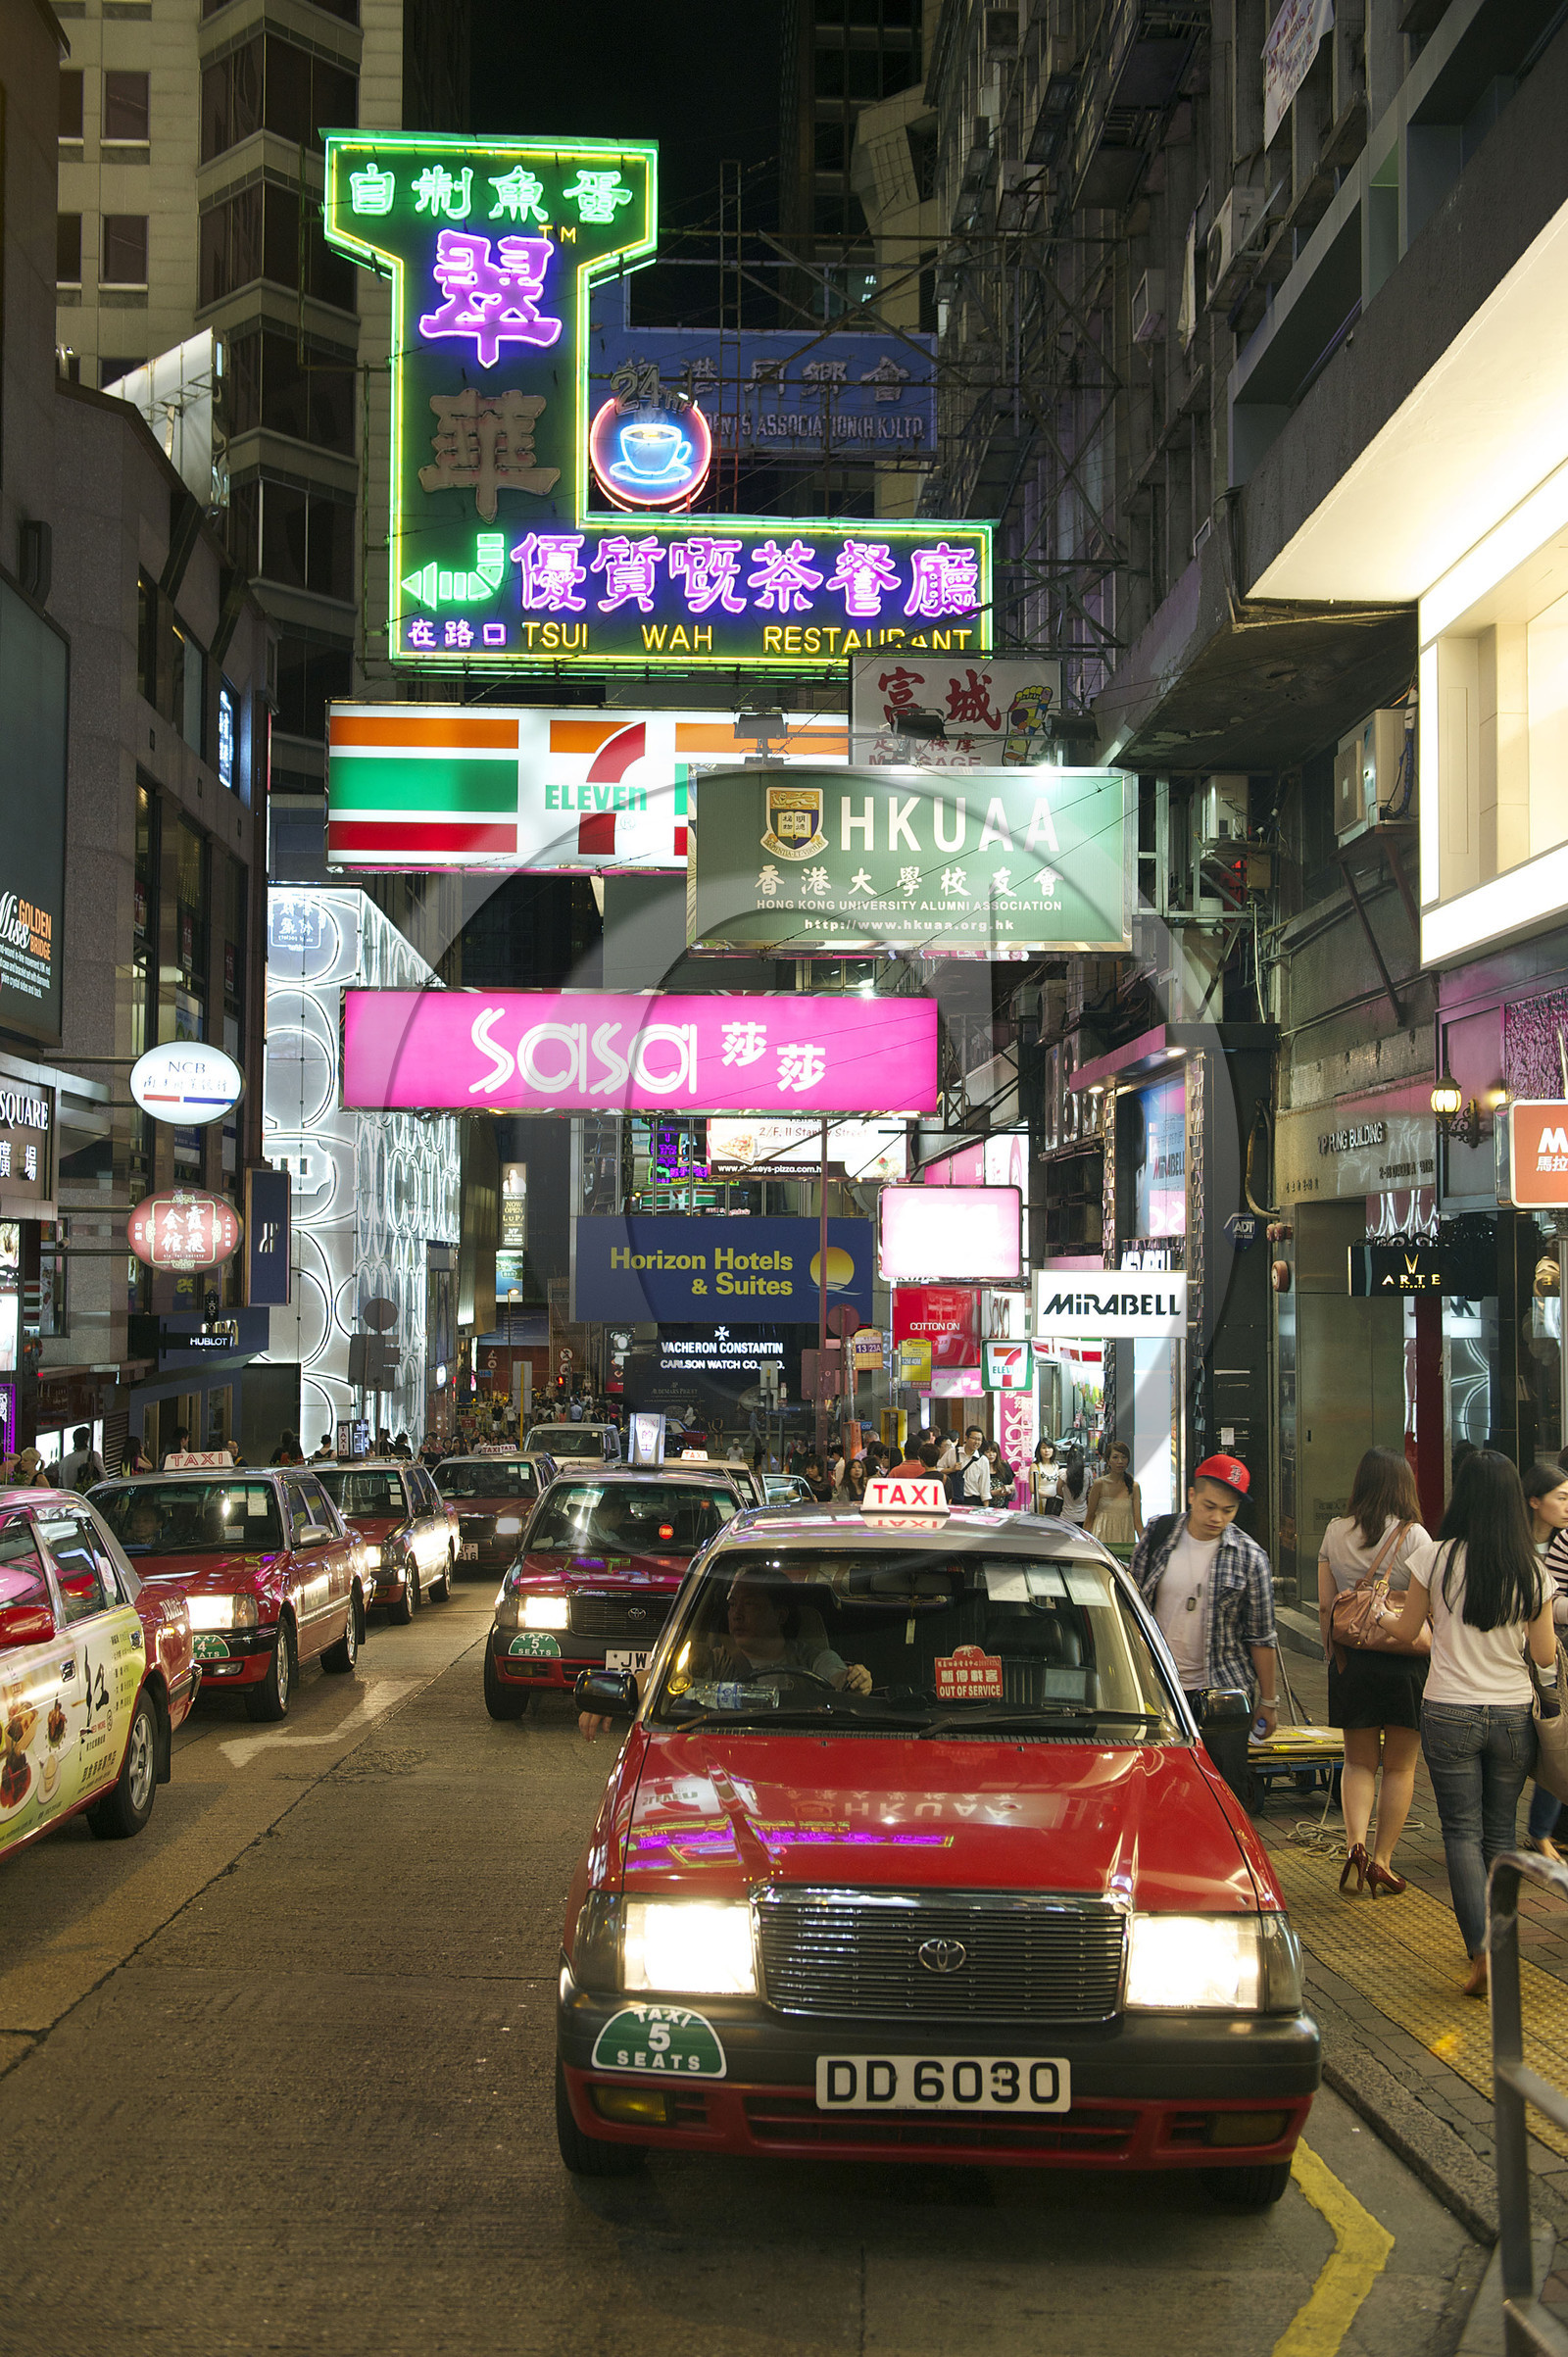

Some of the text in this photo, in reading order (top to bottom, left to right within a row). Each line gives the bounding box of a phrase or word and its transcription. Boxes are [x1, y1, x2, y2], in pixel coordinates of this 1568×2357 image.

[350, 163, 633, 224] 自制魚蛋
[538, 224, 576, 245] TM
[510, 532, 983, 621] 優質嘅茶餐廳
[408, 618, 508, 649] 在路口
[521, 621, 588, 652] TSUI
[640, 623, 713, 653] WAH
[841, 796, 1060, 853] HKUAA
[754, 864, 1065, 898] 香港大學校友會
[757, 899, 1063, 911] HONG KONG UNIVERSITY ALUMNI ASSOCIATION
[19, 899, 52, 941] GOLDEN
[804, 917, 1015, 932] http://www.hkuaa.org.hk
[30, 933, 51, 961] BRIDGE
[168, 1060, 206, 1073] NCB
[720, 1020, 827, 1094] 莎莎
[0, 1089, 49, 1131] SQUARE
[1348, 1121, 1383, 1149] BUILDING
[1233, 1221, 1254, 1233] ADT
[610, 1247, 794, 1271] Horizon Hotels
[690, 1272, 794, 1296] & Suites
[1381, 1273, 1443, 1286] ARTE
[909, 1322, 945, 1331] COTTON
[189, 1337, 228, 1347] HUBLOT
[660, 1342, 784, 1356] VACHERON CONSTANTIN
[856, 1344, 882, 1353] 13 23A
[660, 1359, 706, 1369] CARLSON
[707, 1359, 741, 1369] WATCH
[171, 1452, 223, 1467] TAXI
[872, 1484, 939, 1505] TAXI
[197, 1641, 207, 1652] 4
[530, 1638, 540, 1649] 5
[620, 1652, 648, 1669] JW
[939, 1684, 1002, 1697] OUT OF SERVICE
[632, 2005, 691, 2029] TAXI
[647, 2023, 672, 2052] 5
[615, 2049, 702, 2072] SEATS
[826, 2059, 1060, 2104] DD 6030
